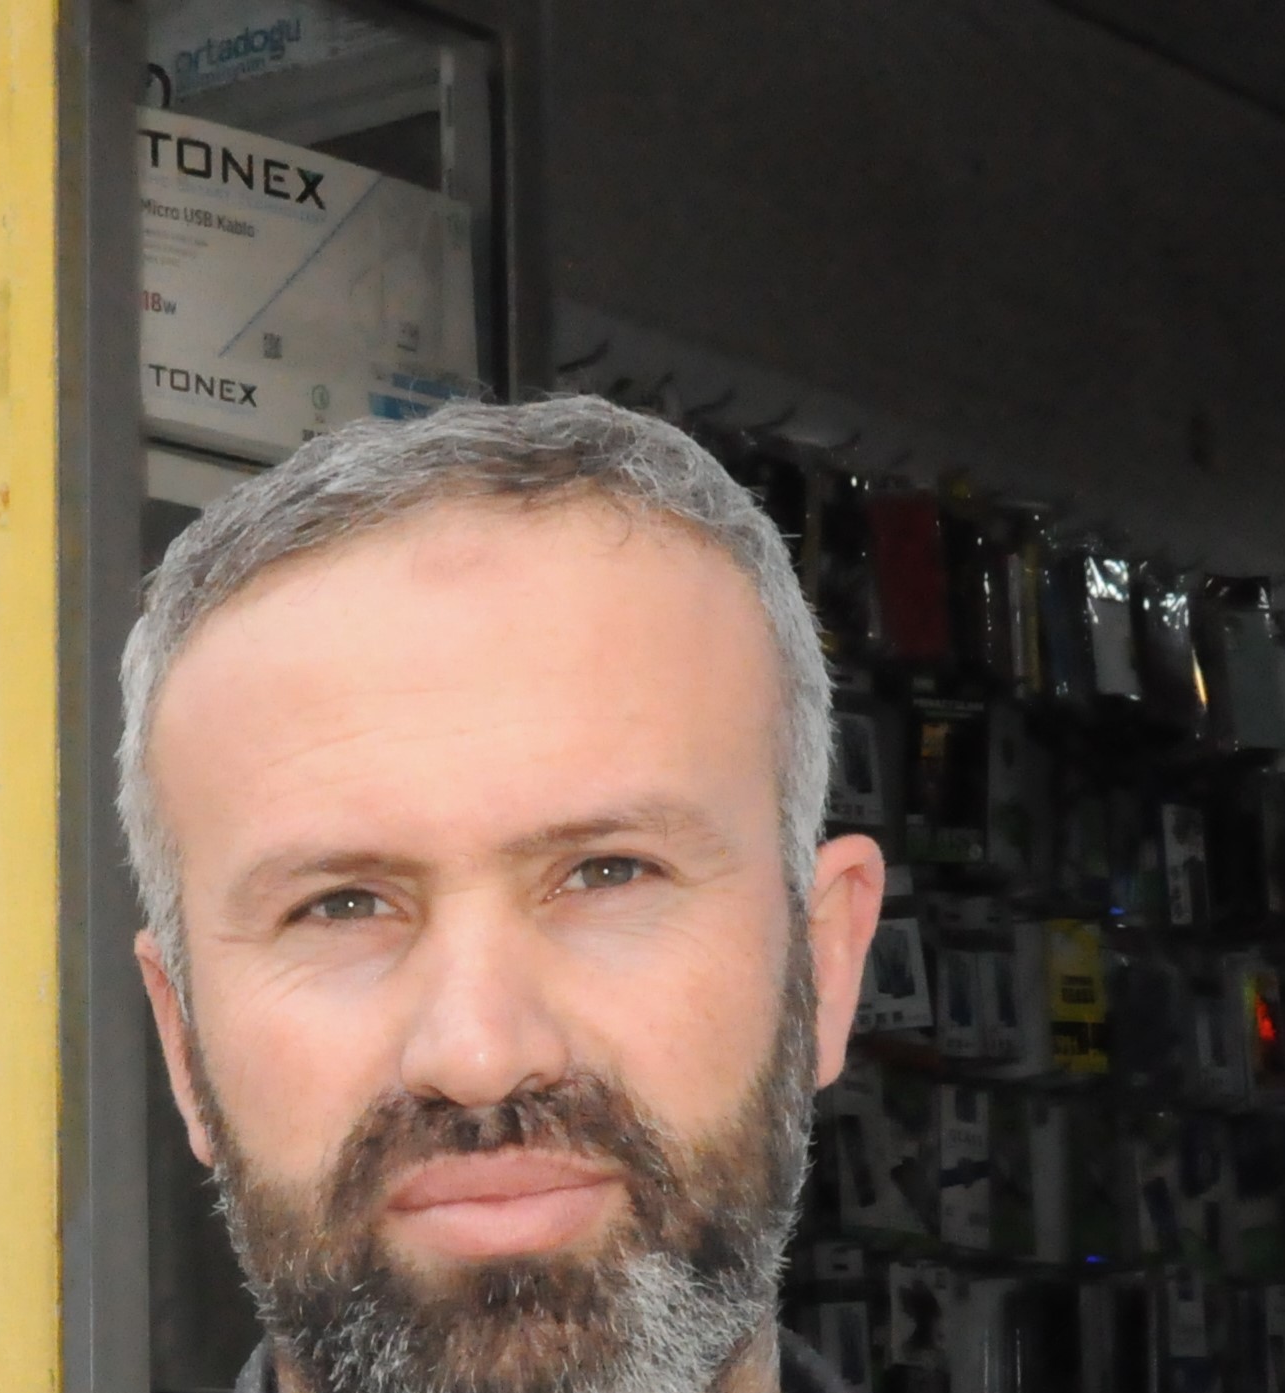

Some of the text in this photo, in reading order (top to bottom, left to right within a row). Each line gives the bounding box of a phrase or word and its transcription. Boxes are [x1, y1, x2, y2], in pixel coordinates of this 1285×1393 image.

[139, 129, 327, 210] TONEX
[184, 206, 213, 227] USB
[148, 363, 258, 408] TONEX
